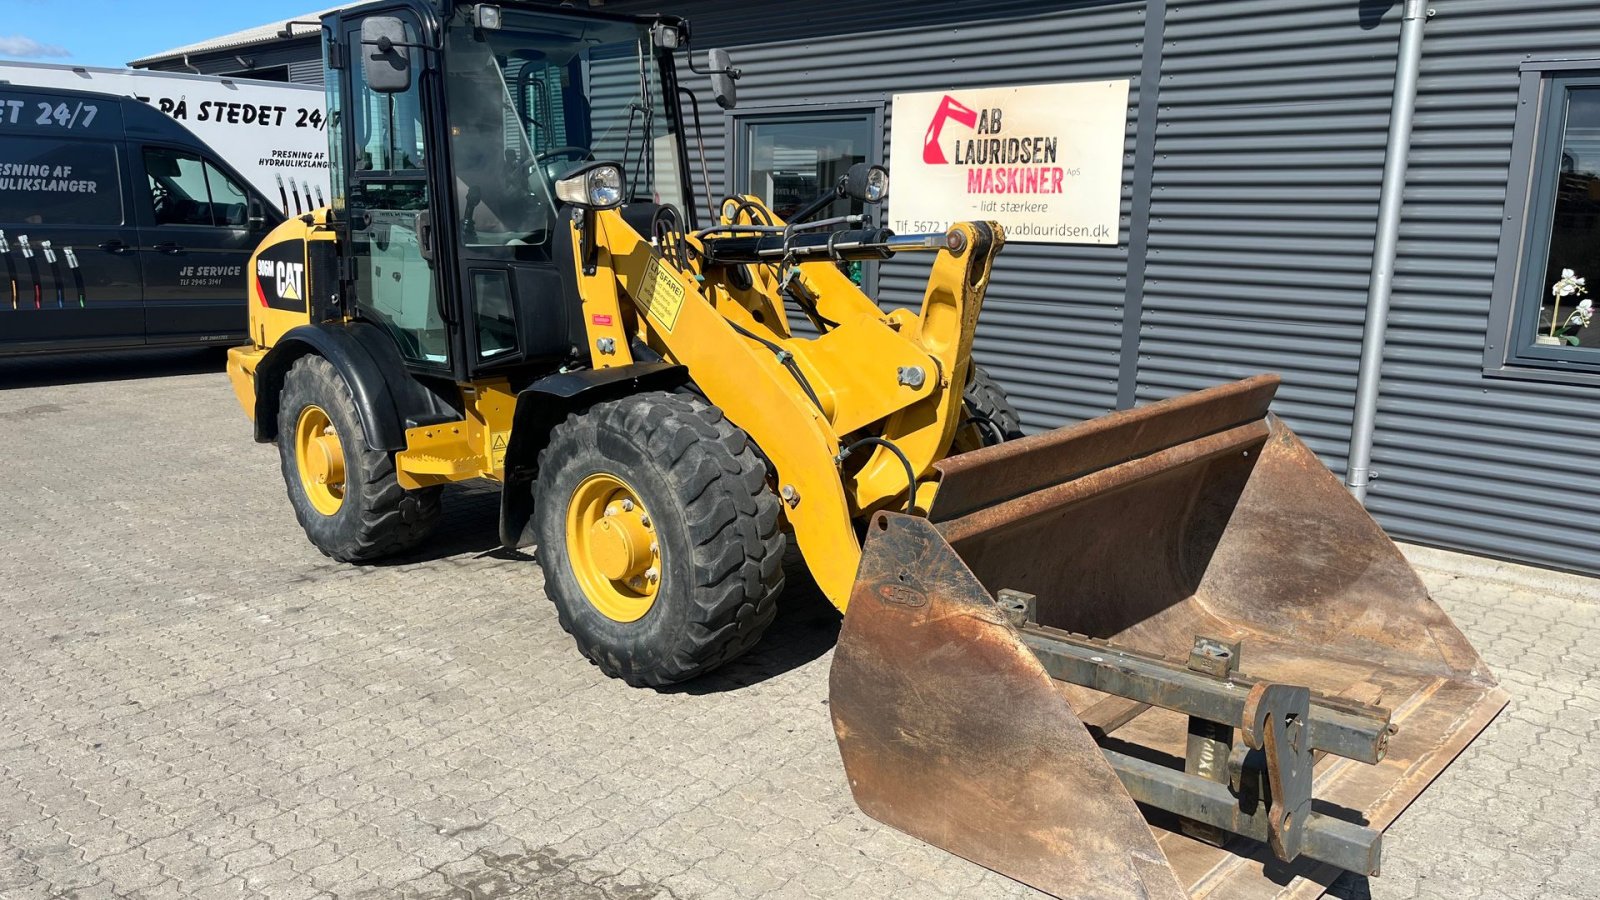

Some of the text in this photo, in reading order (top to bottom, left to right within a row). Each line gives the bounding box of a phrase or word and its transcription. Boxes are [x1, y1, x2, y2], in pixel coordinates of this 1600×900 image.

[36, 102, 98, 129] 24/7
[197, 101, 287, 127] STEDET
[977, 108, 1003, 135] AB
[272, 150, 325, 160] PRESNING AF
[955, 137, 1058, 165] LAURIDSEN
[53, 166, 72, 178] AF
[967, 167, 1081, 194] MASKINER ApS
[981, 201, 997, 212] lidt
[1000, 201, 1049, 213] stærkere
[895, 220, 911, 235] Tlf.
[914, 221, 940, 233] 5672
[180, 266, 241, 276] JE SERVICE
[257, 259, 275, 277] 906M
[276, 260, 304, 300] CAT
